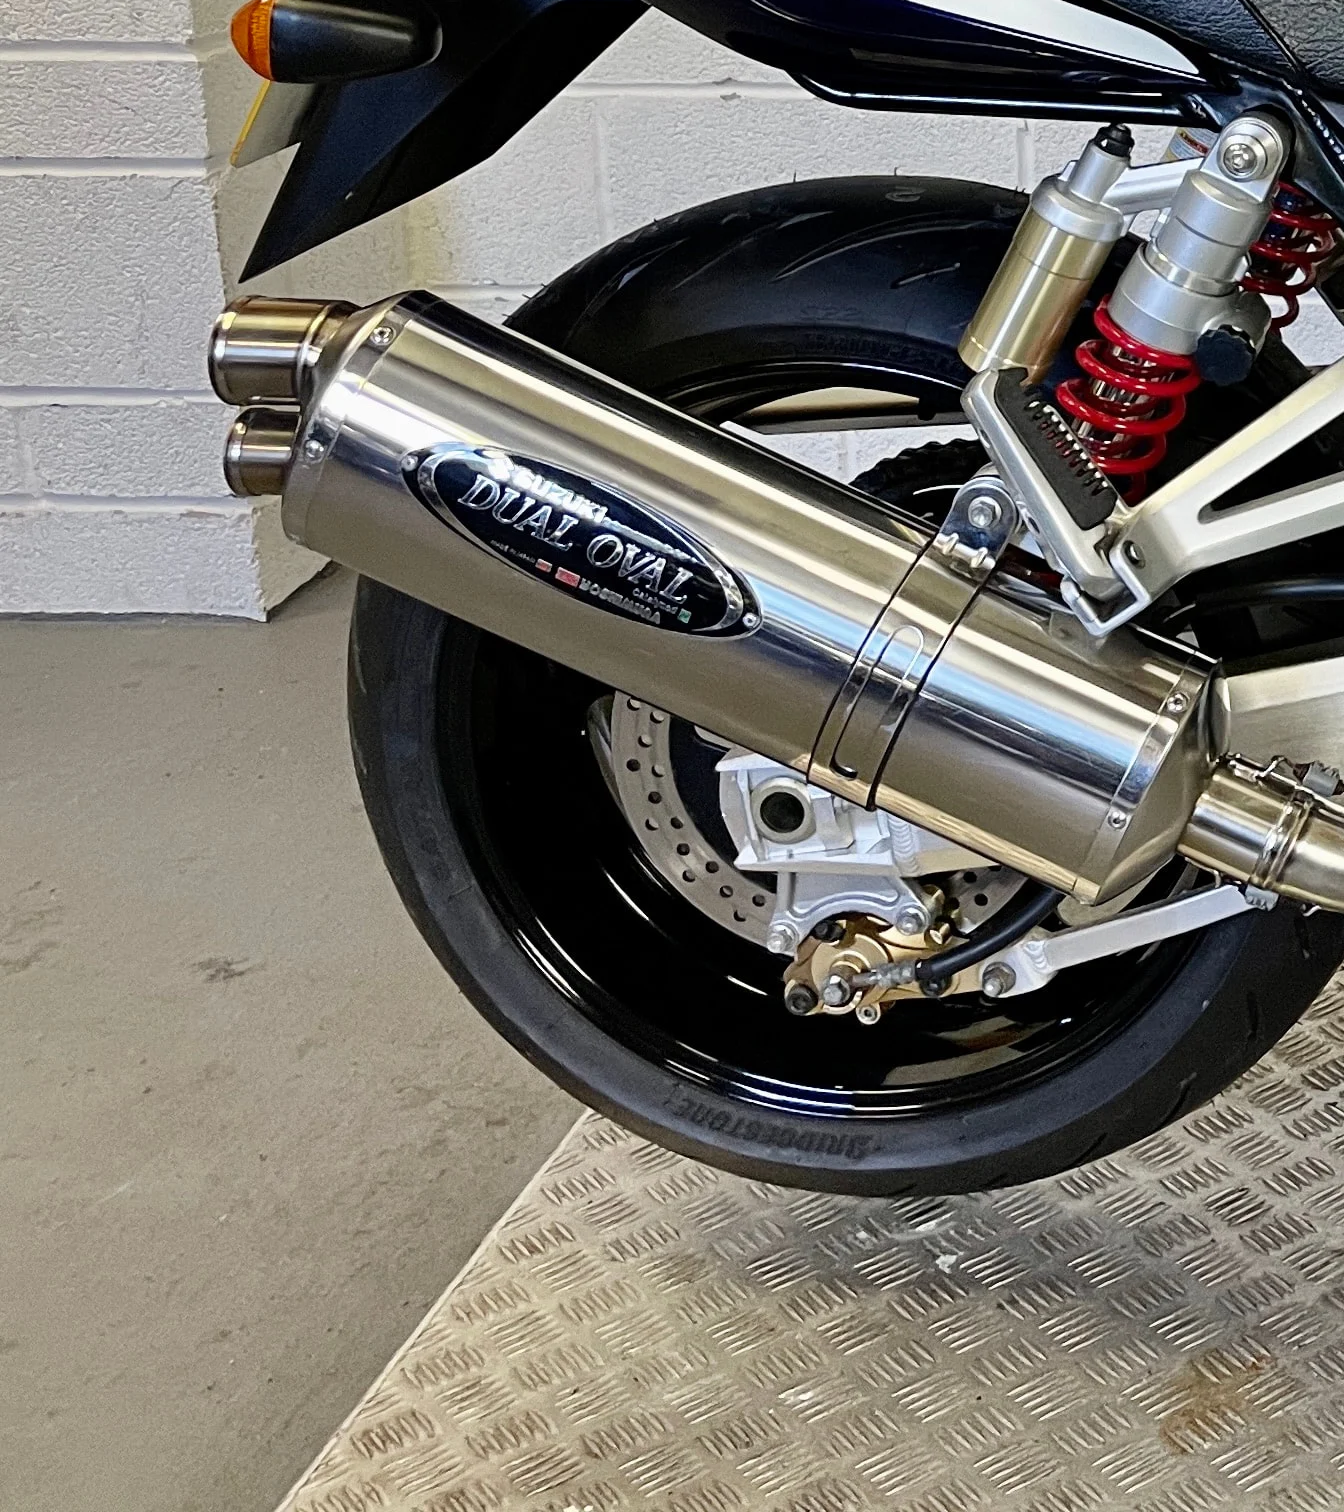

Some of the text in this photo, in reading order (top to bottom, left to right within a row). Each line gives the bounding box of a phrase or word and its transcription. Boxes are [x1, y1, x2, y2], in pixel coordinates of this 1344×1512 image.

[457, 472, 694, 605] DUAL OVAL
[508, 462, 609, 525] SUZUKI
